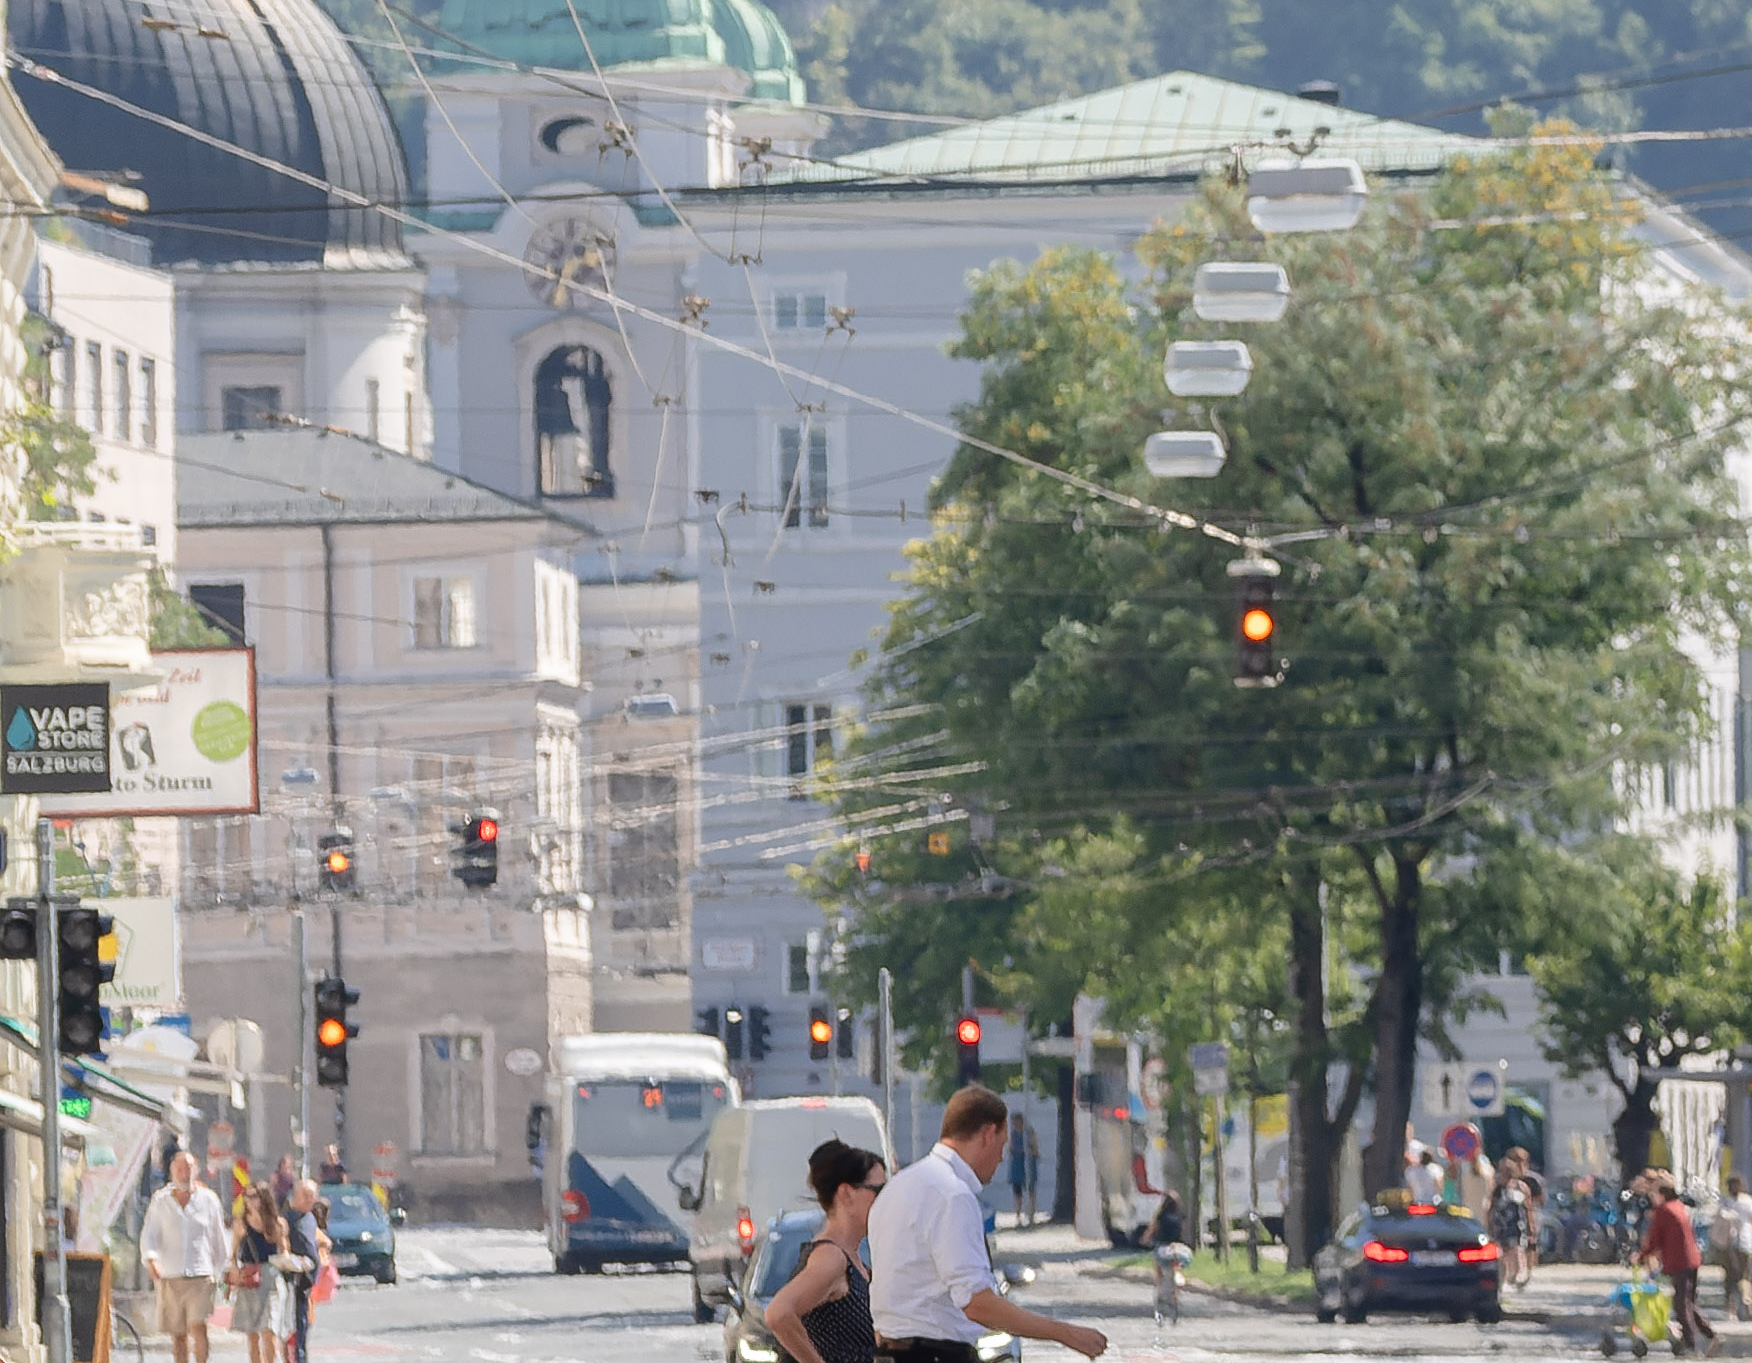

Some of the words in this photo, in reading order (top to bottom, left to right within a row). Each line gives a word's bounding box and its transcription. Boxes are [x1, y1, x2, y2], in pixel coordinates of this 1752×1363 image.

[30, 705, 105, 732] VAPE
[38, 730, 106, 750] STORE
[6, 755, 106, 775] SALZBURG
